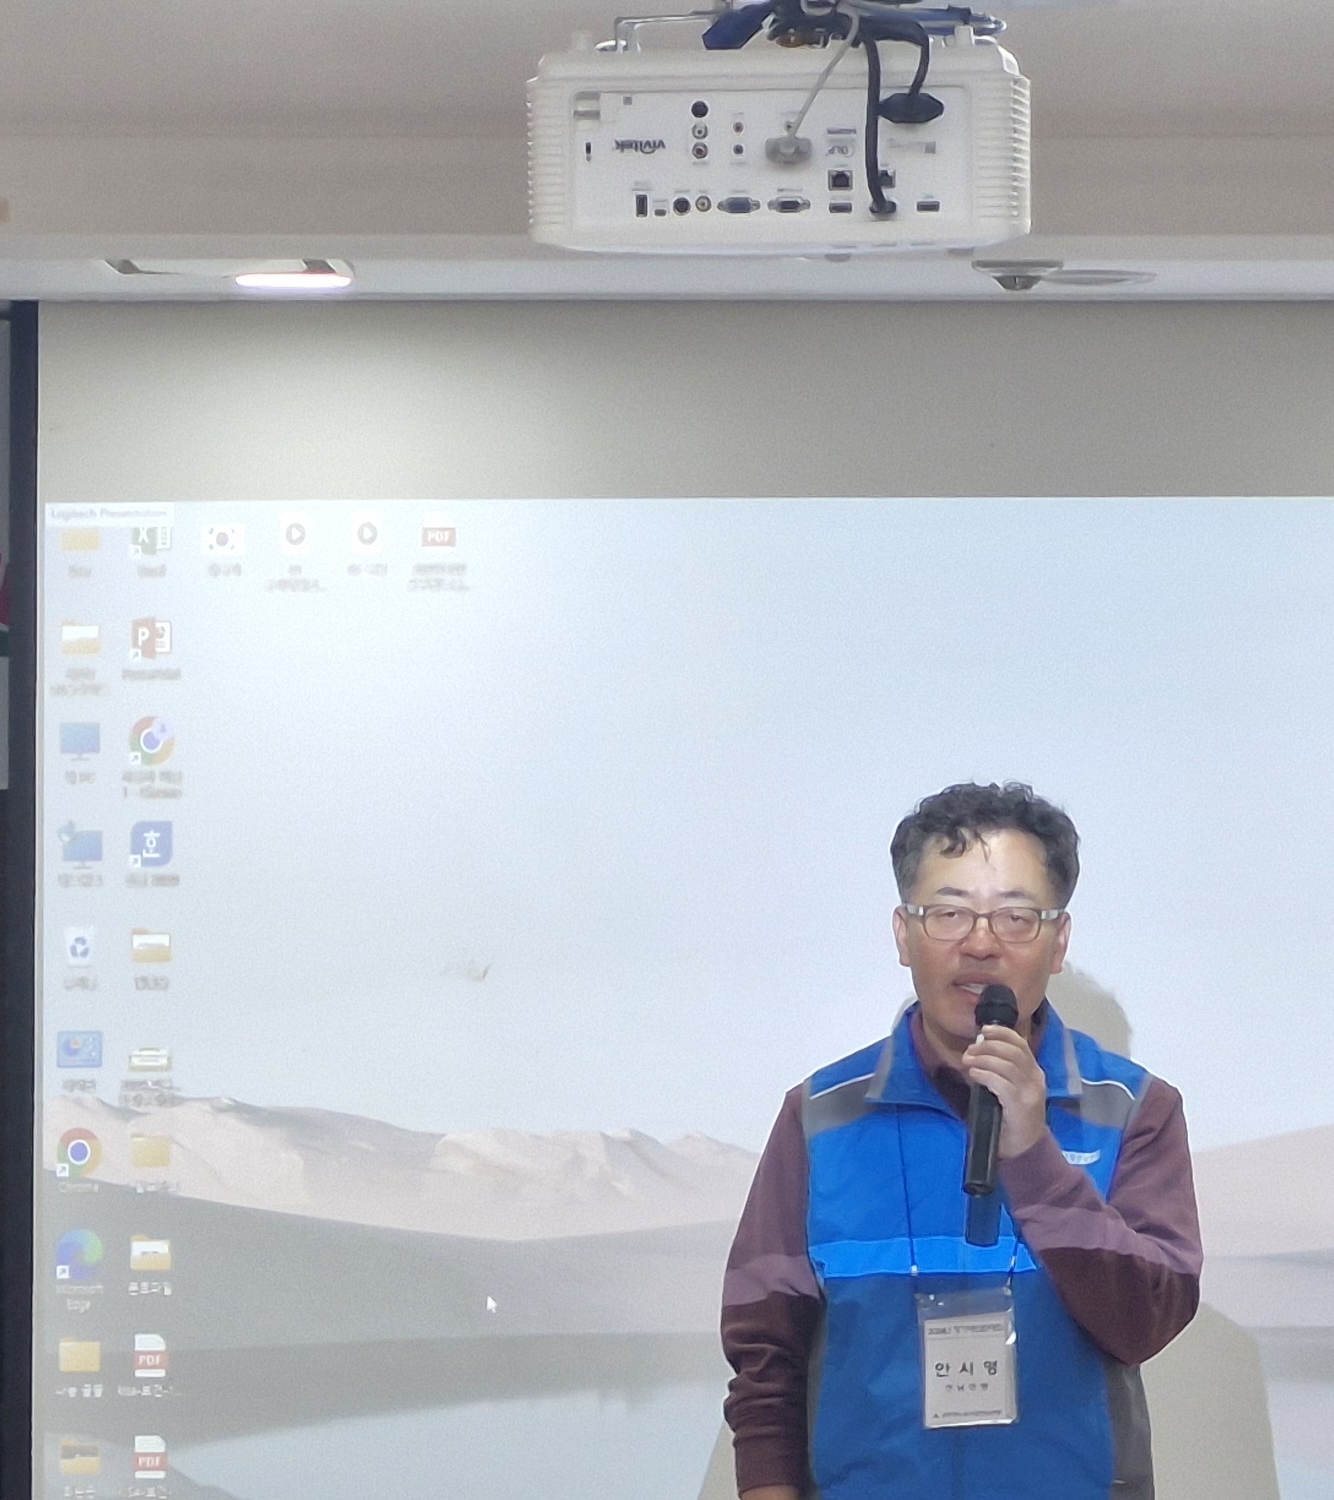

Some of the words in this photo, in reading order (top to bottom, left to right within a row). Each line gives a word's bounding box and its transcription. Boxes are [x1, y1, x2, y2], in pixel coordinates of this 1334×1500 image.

[614, 138, 666, 156] vivitek
[138, 1354, 162, 1366] PDF
[137, 1456, 162, 1468] PDF
